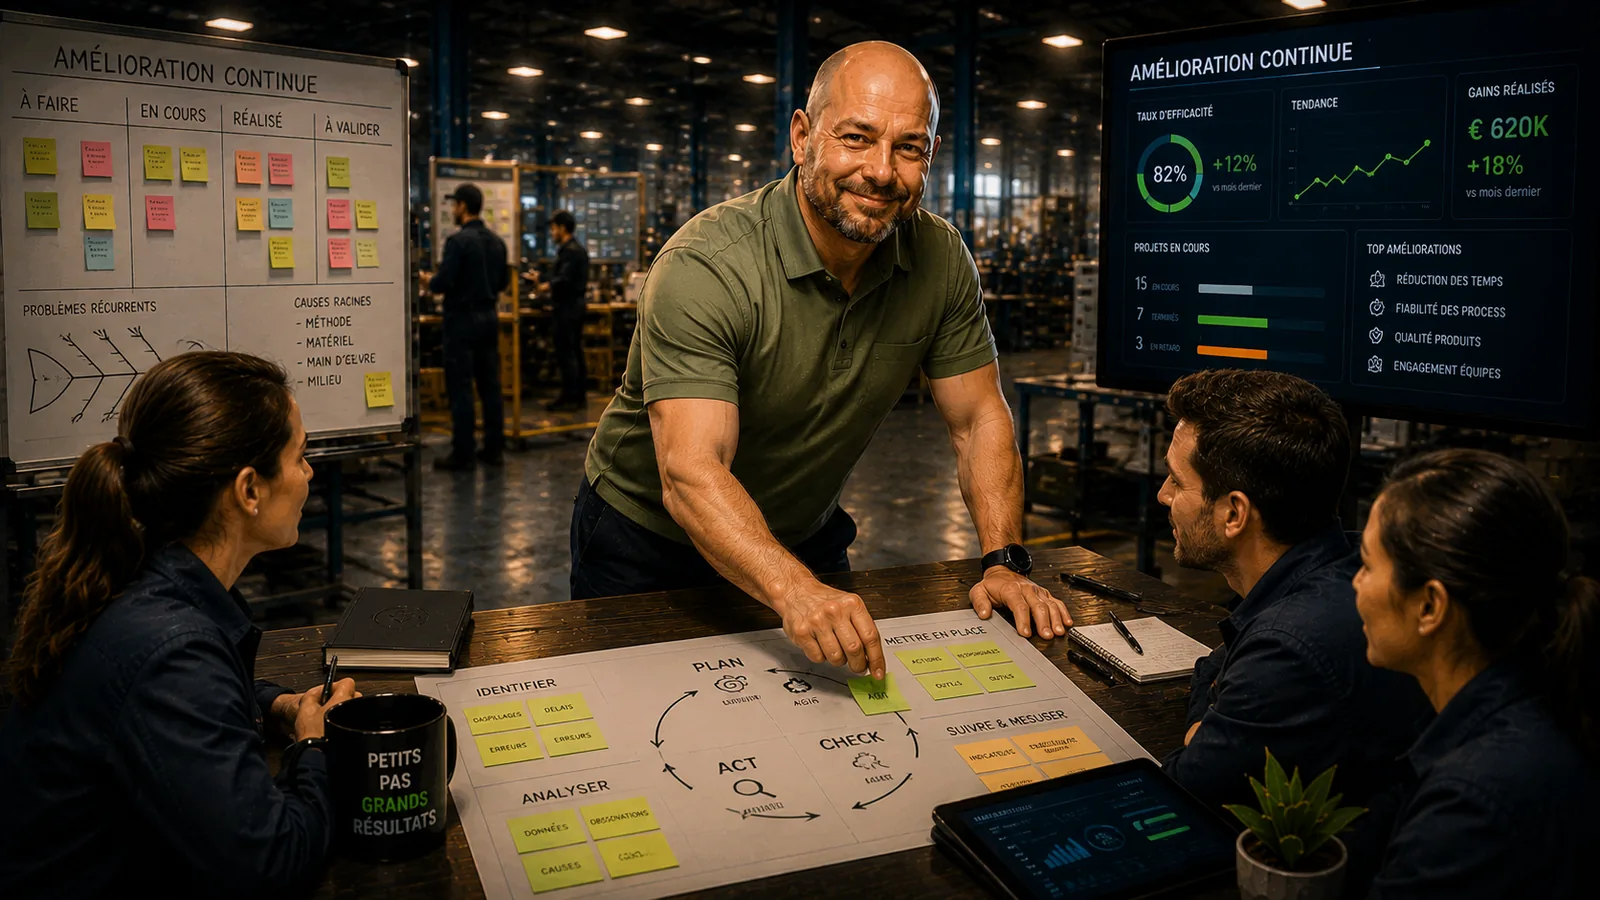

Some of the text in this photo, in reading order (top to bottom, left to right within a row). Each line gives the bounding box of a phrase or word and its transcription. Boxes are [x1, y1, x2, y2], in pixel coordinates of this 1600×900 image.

[54, 46, 318, 94] AMÉLIORATION CONTINUE
[1130, 42, 1354, 82] AMÉLIORATION CONTINUE
[1468, 79, 1556, 98] GAINS RÉALISÉS
[20, 88, 79, 113] À FAIRE
[1291, 97, 1338, 110] TENDANCE
[140, 103, 206, 122] EN COURS
[233, 108, 282, 128] RÉALISÉ
[1136, 104, 1214, 122] TAUX D'EFFICACITÉ
[324, 115, 380, 136] À VALIDER
[1468, 114, 1550, 141] € 620K
[1213, 154, 1257, 172] +12%
[1467, 155, 1524, 176] +18%
[1153, 165, 1188, 183] 82%
[1238, 182, 1262, 192] dernier
[1466, 184, 1542, 198] vs mois dernier
[1134, 242, 1210, 254] PROJETS EN COURS
[1366, 241, 1462, 256] TOP AMÉLIORATIONS
[1135, 276, 1148, 290] 15
[1396, 272, 1504, 288] RÉDUCTION DES TEMPS
[23, 300, 157, 317] PROBLÈMES RÉCURRENTS
[294, 296, 372, 308] CAUSES RACINES
[1396, 301, 1506, 318] FIABILITÉ DES PROCESS
[306, 314, 352, 328] MÉTHODE
[1136, 306, 1144, 320] 7
[306, 334, 354, 348] MATÉRIEL
[1136, 336, 1144, 350] 3
[1394, 330, 1482, 348] QUALITÉ PRODUITS
[306, 356, 332, 368] MAIN
[1394, 360, 1502, 380] ENGAGEMENT ÉQUIPES
[308, 374, 342, 387] MILIEU
[884, 626, 988, 646] METTRE EN PLACE
[692, 657, 744, 672] PLAN
[476, 678, 557, 697] IDENTIFIER
[946, 720, 995, 736] SUIVRE
[997, 718, 1008, 730] &
[819, 731, 885, 751] CHECK
[368, 748, 422, 769] PETITS
[718, 756, 758, 775] ACT
[380, 772, 411, 790] PAS
[362, 790, 428, 813] GRANDS
[522, 780, 611, 805] ANALYSER
[353, 808, 436, 836] RÉSULTATS
[540, 861, 582, 876] CAUSES
